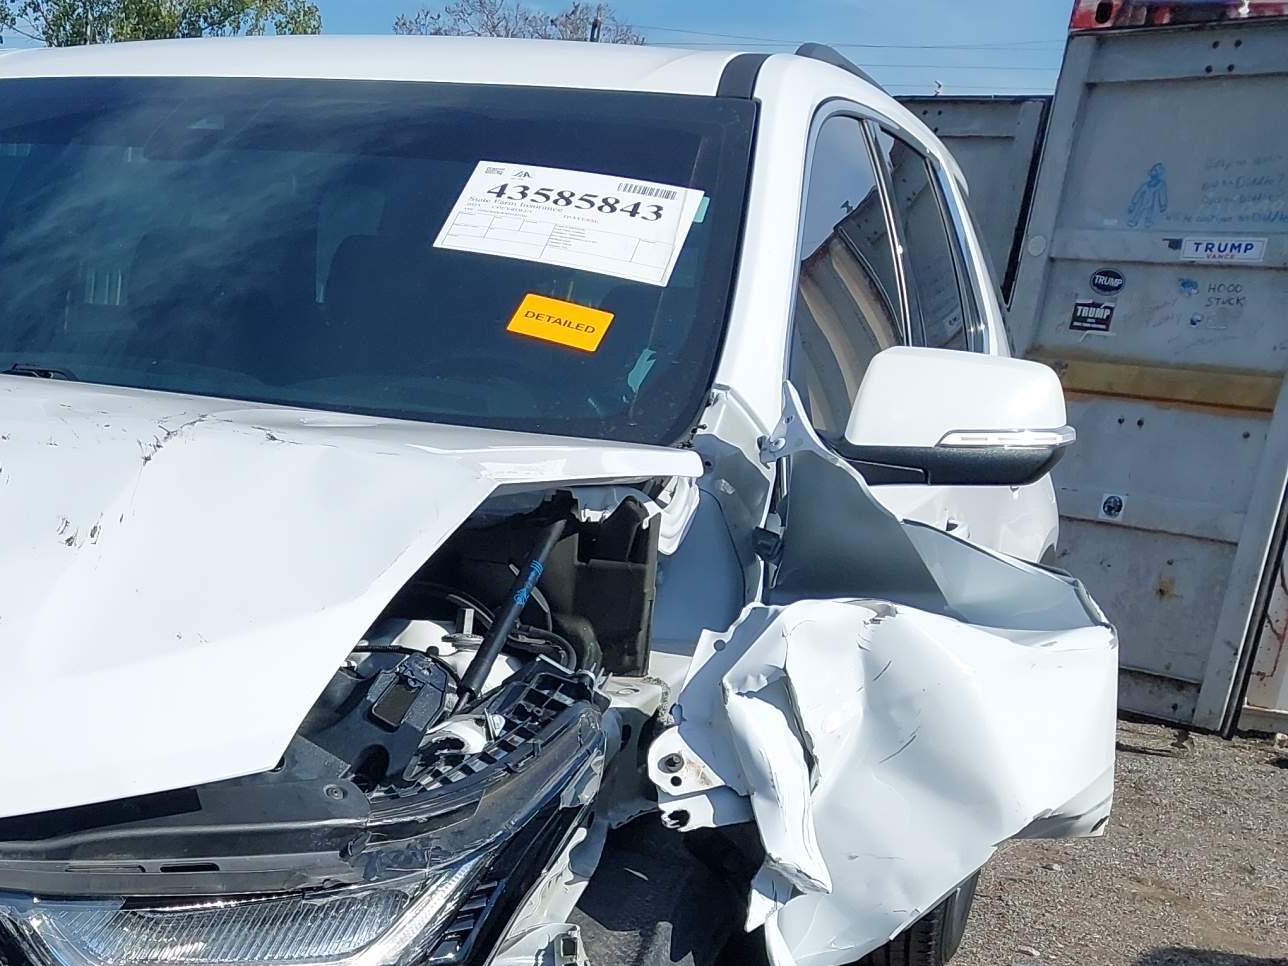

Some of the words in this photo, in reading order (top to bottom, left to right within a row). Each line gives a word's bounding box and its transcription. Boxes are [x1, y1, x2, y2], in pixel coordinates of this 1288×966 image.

[487, 183, 663, 221] 43585843
[1193, 242, 1254, 254] TRUMP
[1094, 275, 1123, 287] TRUMP
[1076, 306, 1111, 319] TRUMP
[524, 310, 596, 335] DETAILED
